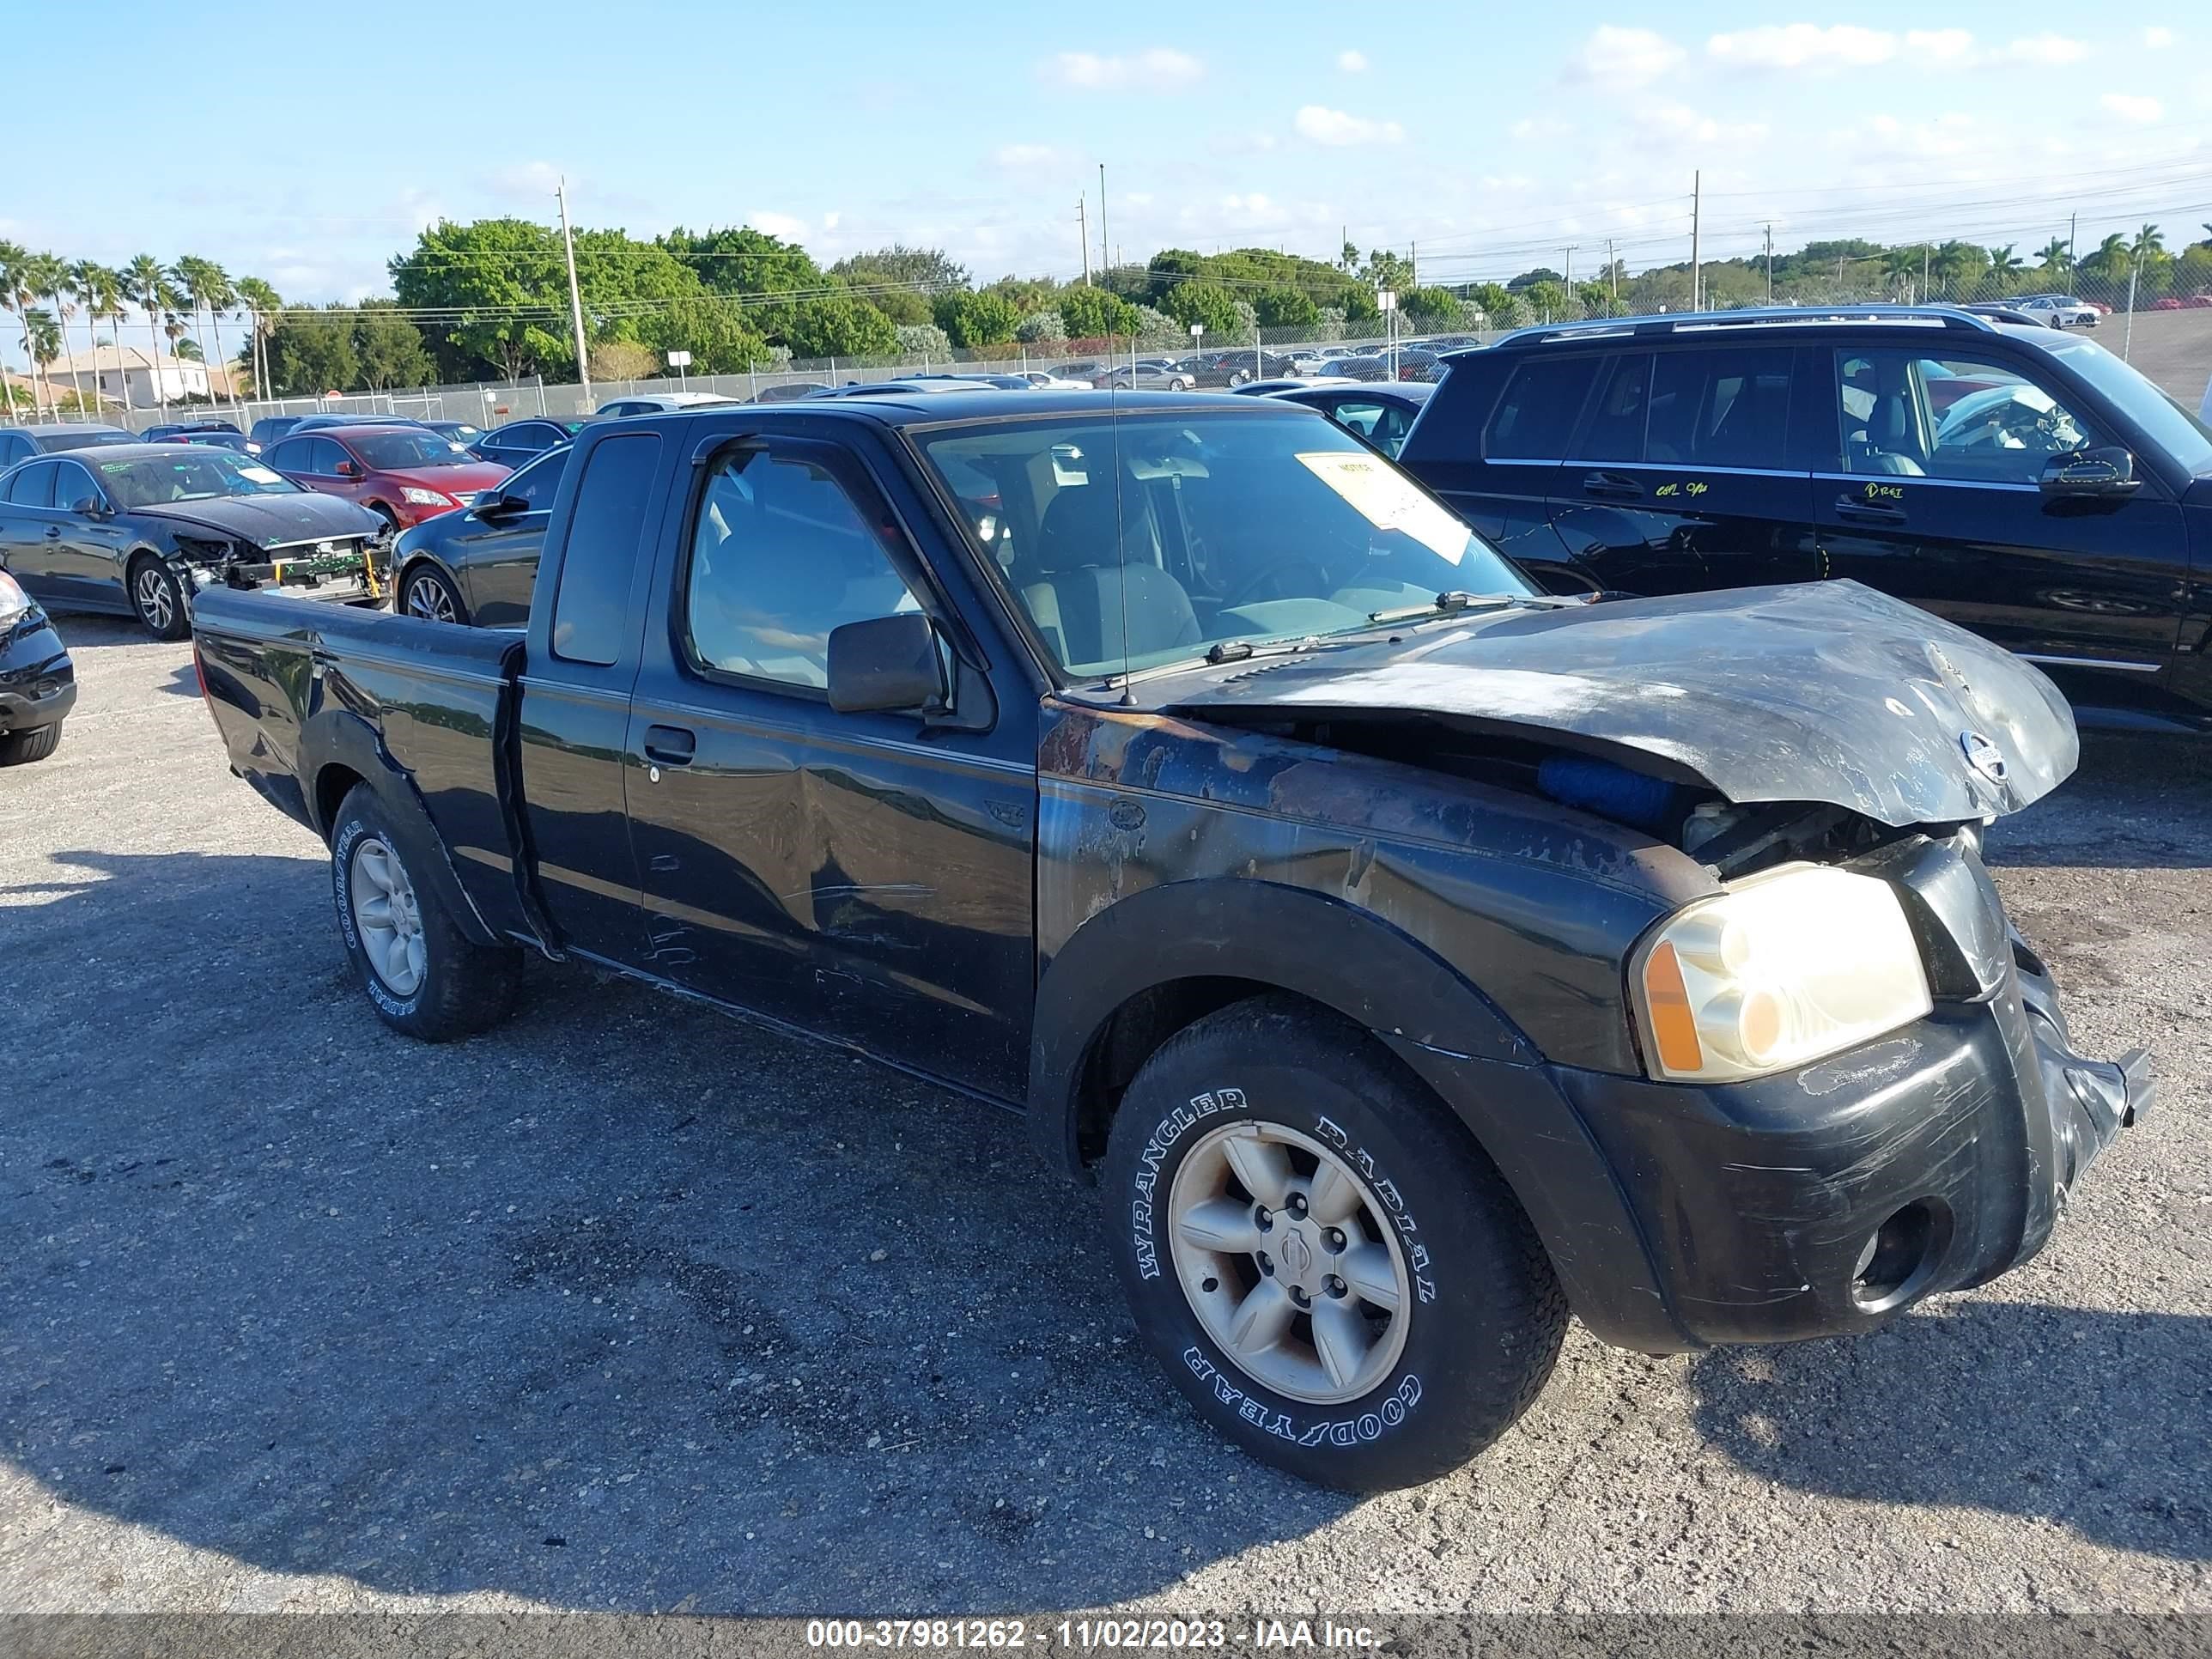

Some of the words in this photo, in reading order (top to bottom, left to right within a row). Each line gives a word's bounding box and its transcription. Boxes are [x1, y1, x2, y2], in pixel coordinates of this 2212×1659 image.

[1128, 1087, 1249, 1281] WRANGLER
[1314, 1115, 1437, 1304] RADIAL
[1182, 1345, 1424, 1448] GOODYEAR
